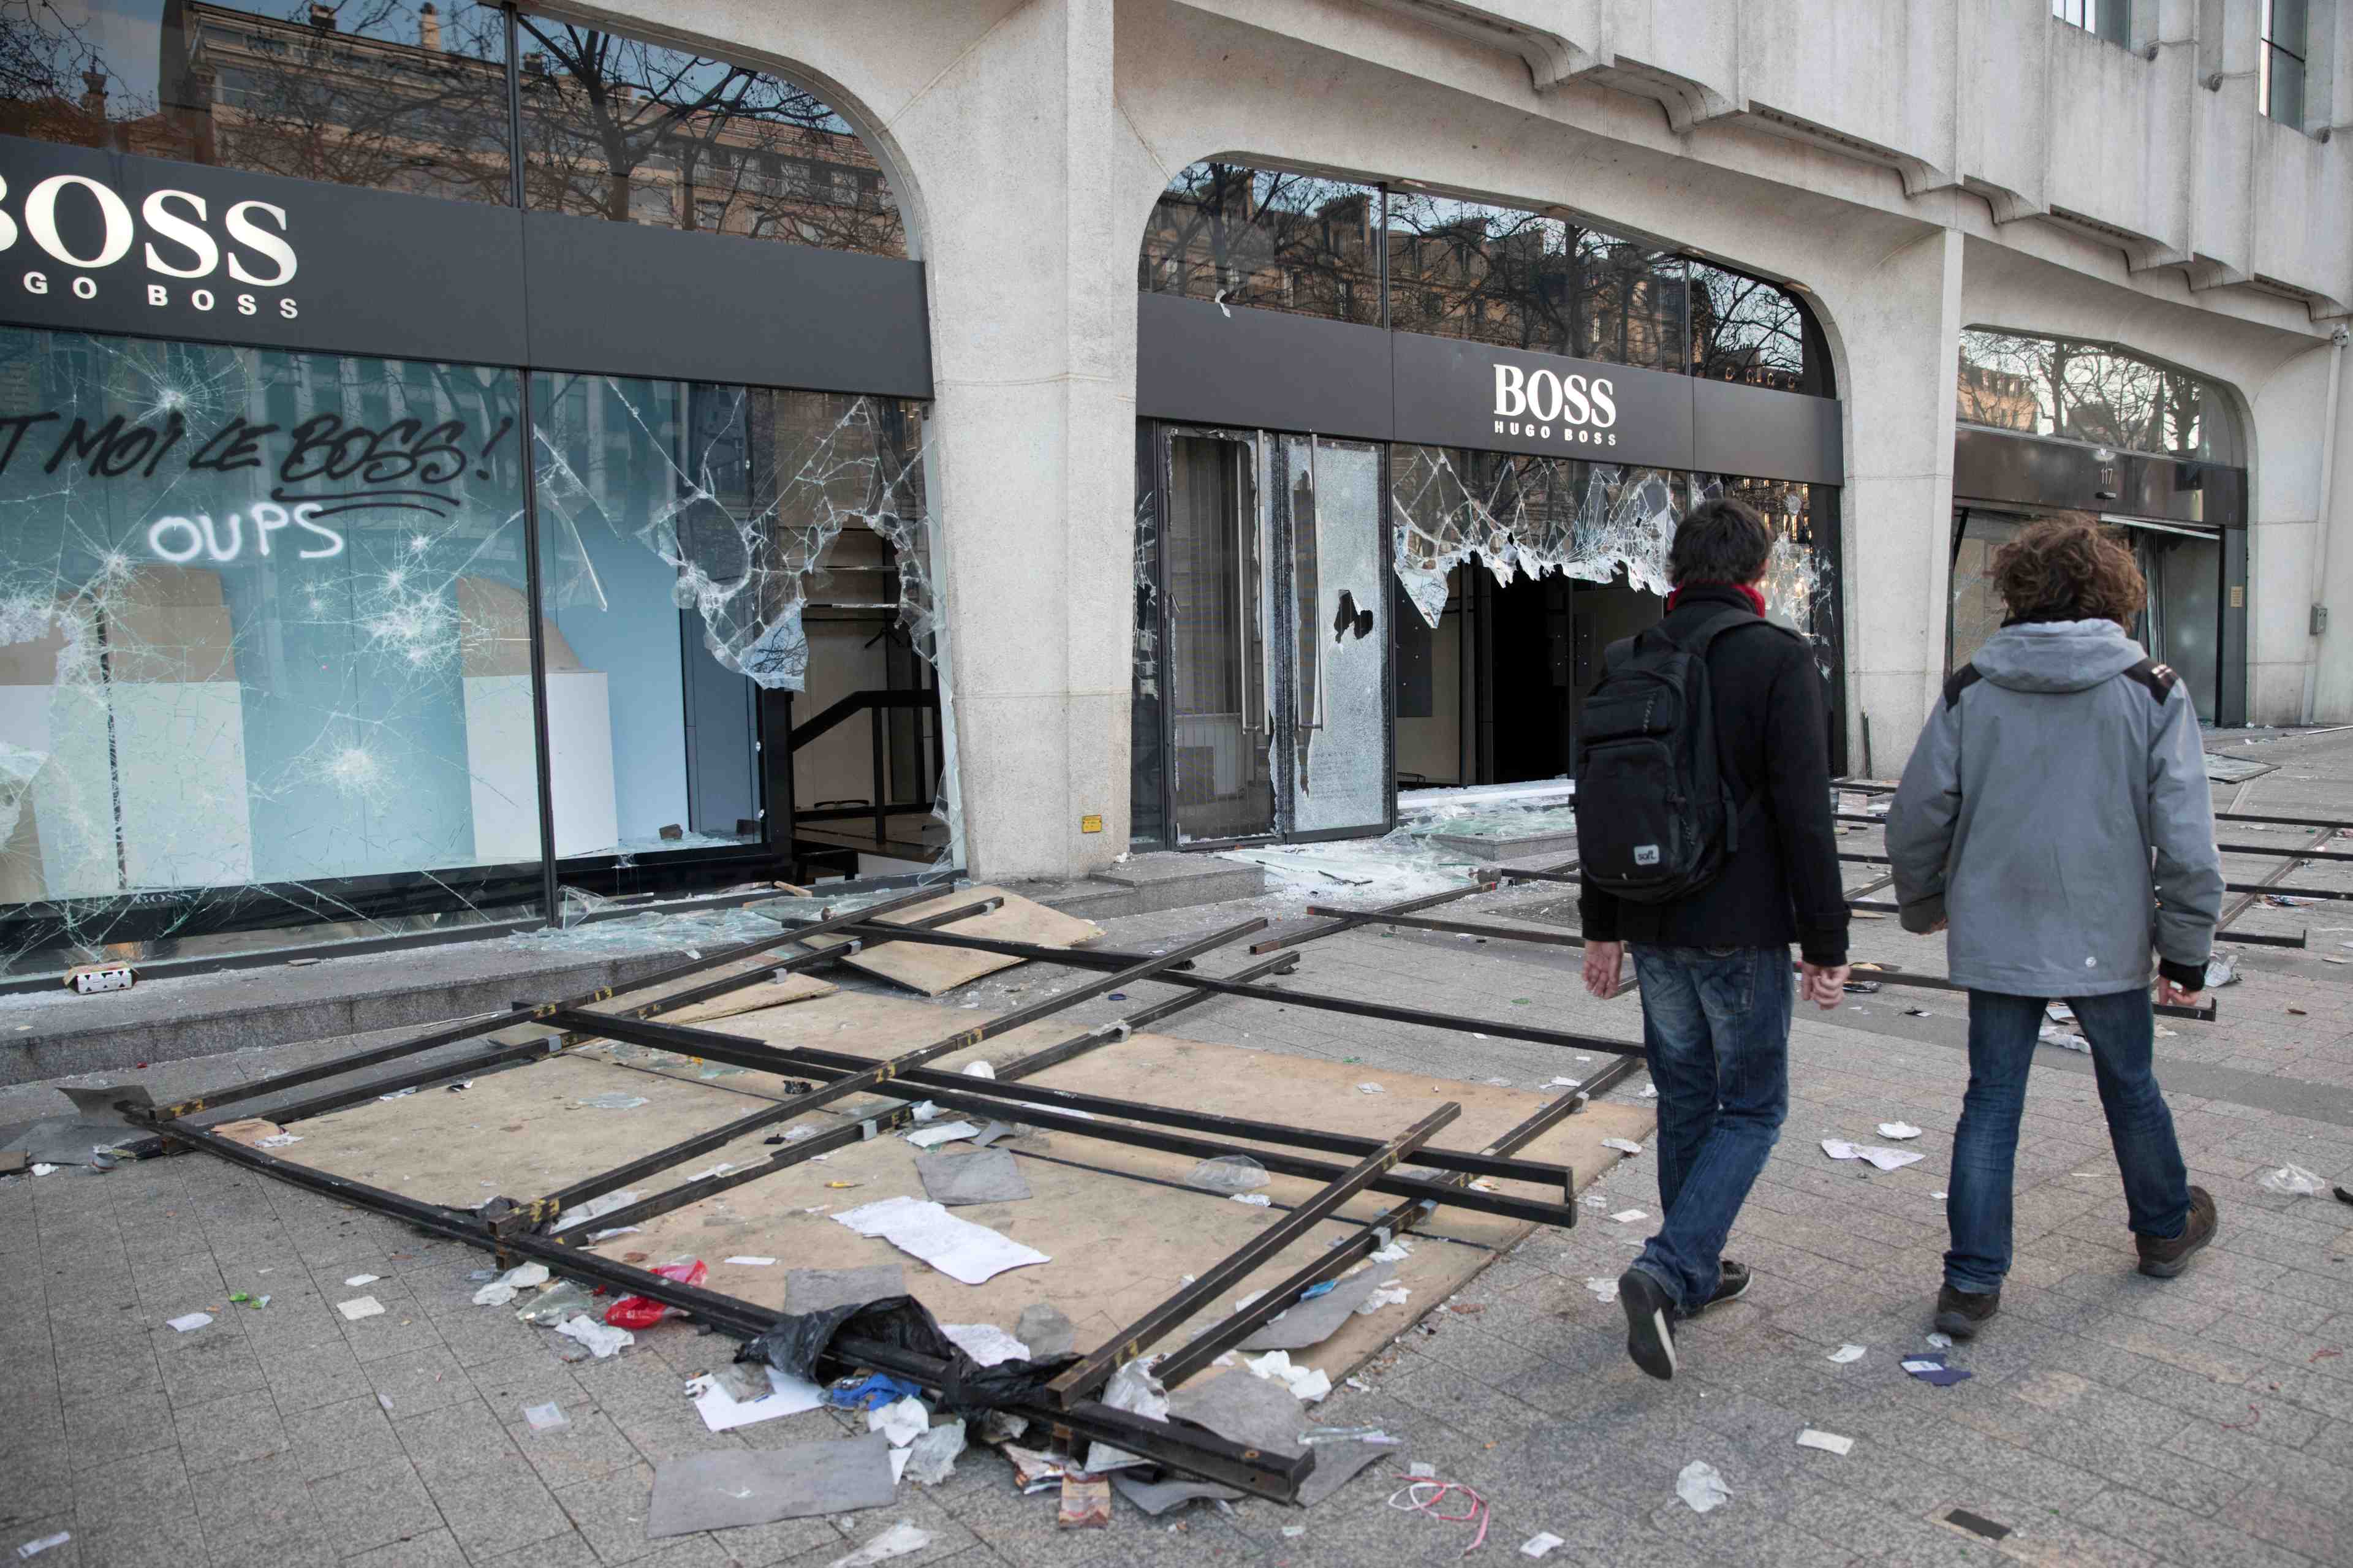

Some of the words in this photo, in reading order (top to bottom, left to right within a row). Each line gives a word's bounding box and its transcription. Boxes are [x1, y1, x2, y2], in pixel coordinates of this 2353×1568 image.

[0, 174, 298, 287] OSS
[148, 284, 298, 319] BOSS
[1493, 363, 1616, 428] BOSS
[44, 411, 186, 477] MOI
[188, 417, 280, 472] LE
[1495, 421, 1550, 439] HUGO
[1564, 428, 1616, 446] BOSS
[2101, 468, 2113, 485] 117
[148, 501, 344, 562] OUPS
[135, 892, 192, 904] BOSS
